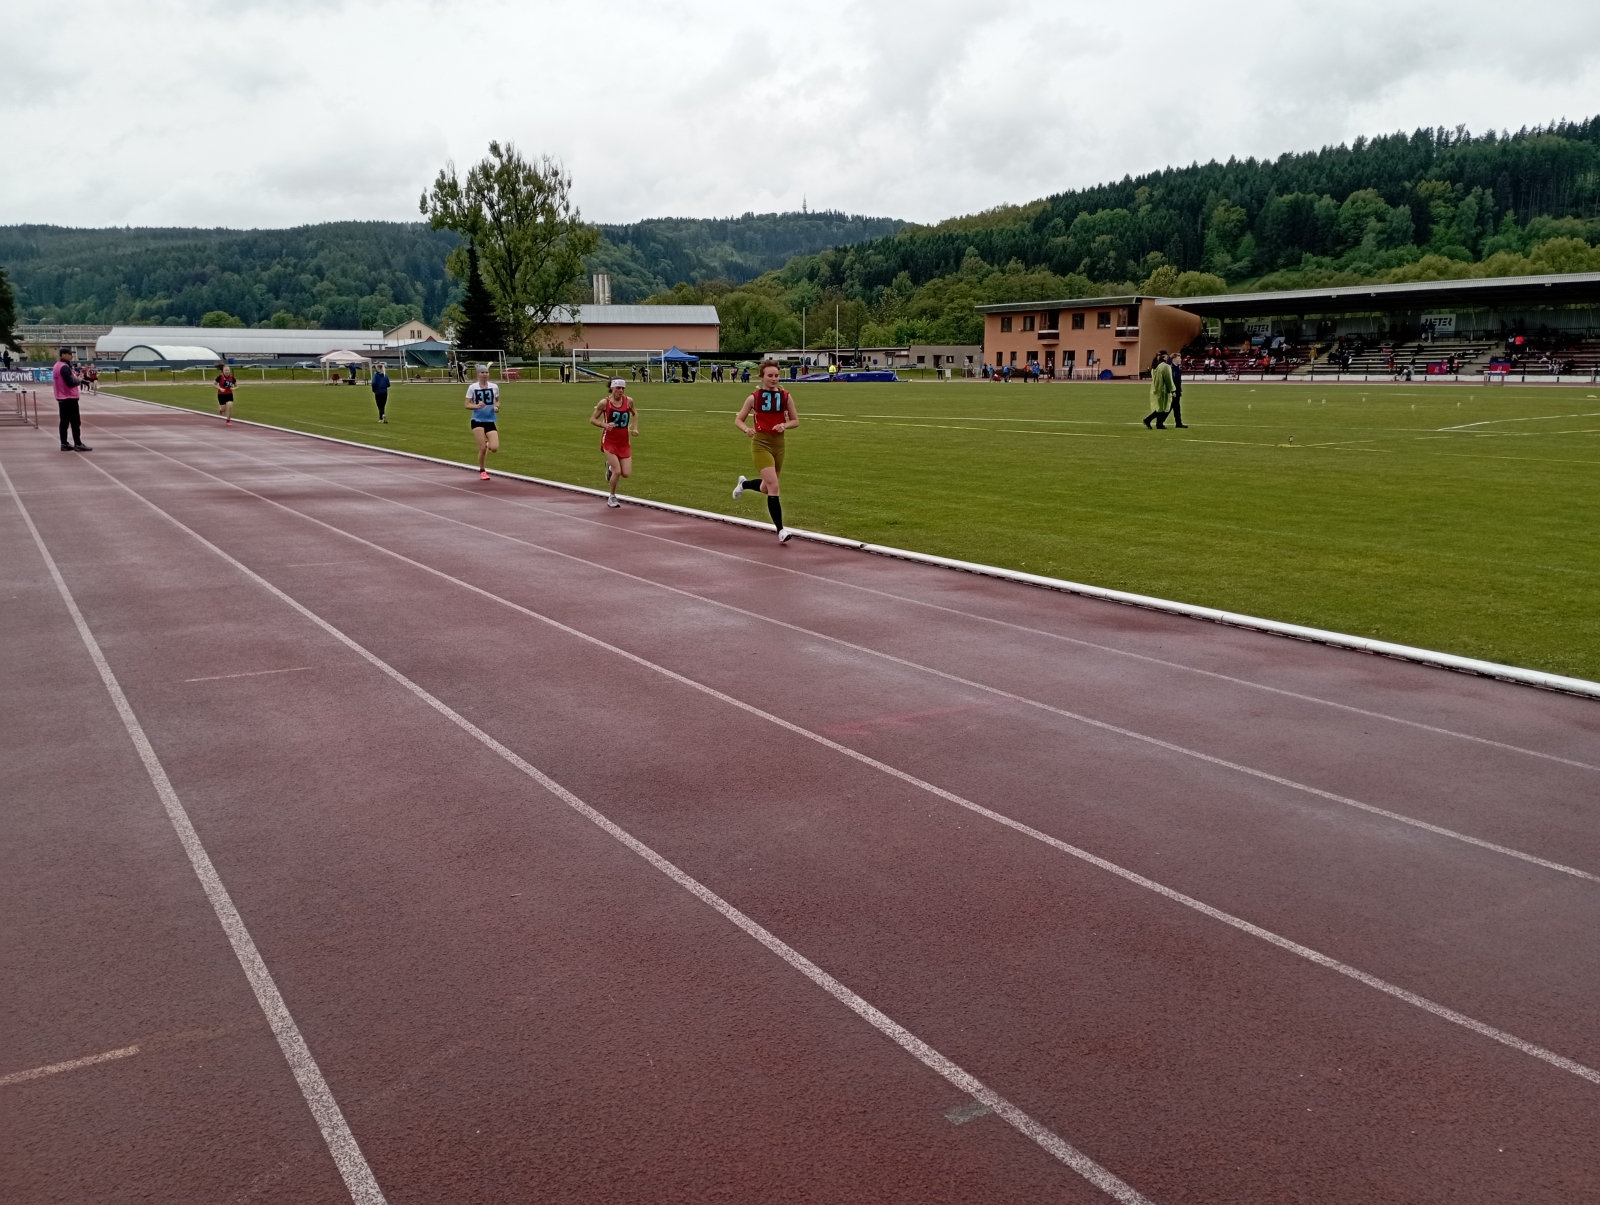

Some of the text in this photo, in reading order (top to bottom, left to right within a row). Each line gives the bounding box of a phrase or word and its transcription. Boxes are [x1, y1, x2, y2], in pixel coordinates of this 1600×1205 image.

[477, 390, 492, 403] 33
[761, 391, 781, 411] 31
[612, 411, 628, 427] 29
